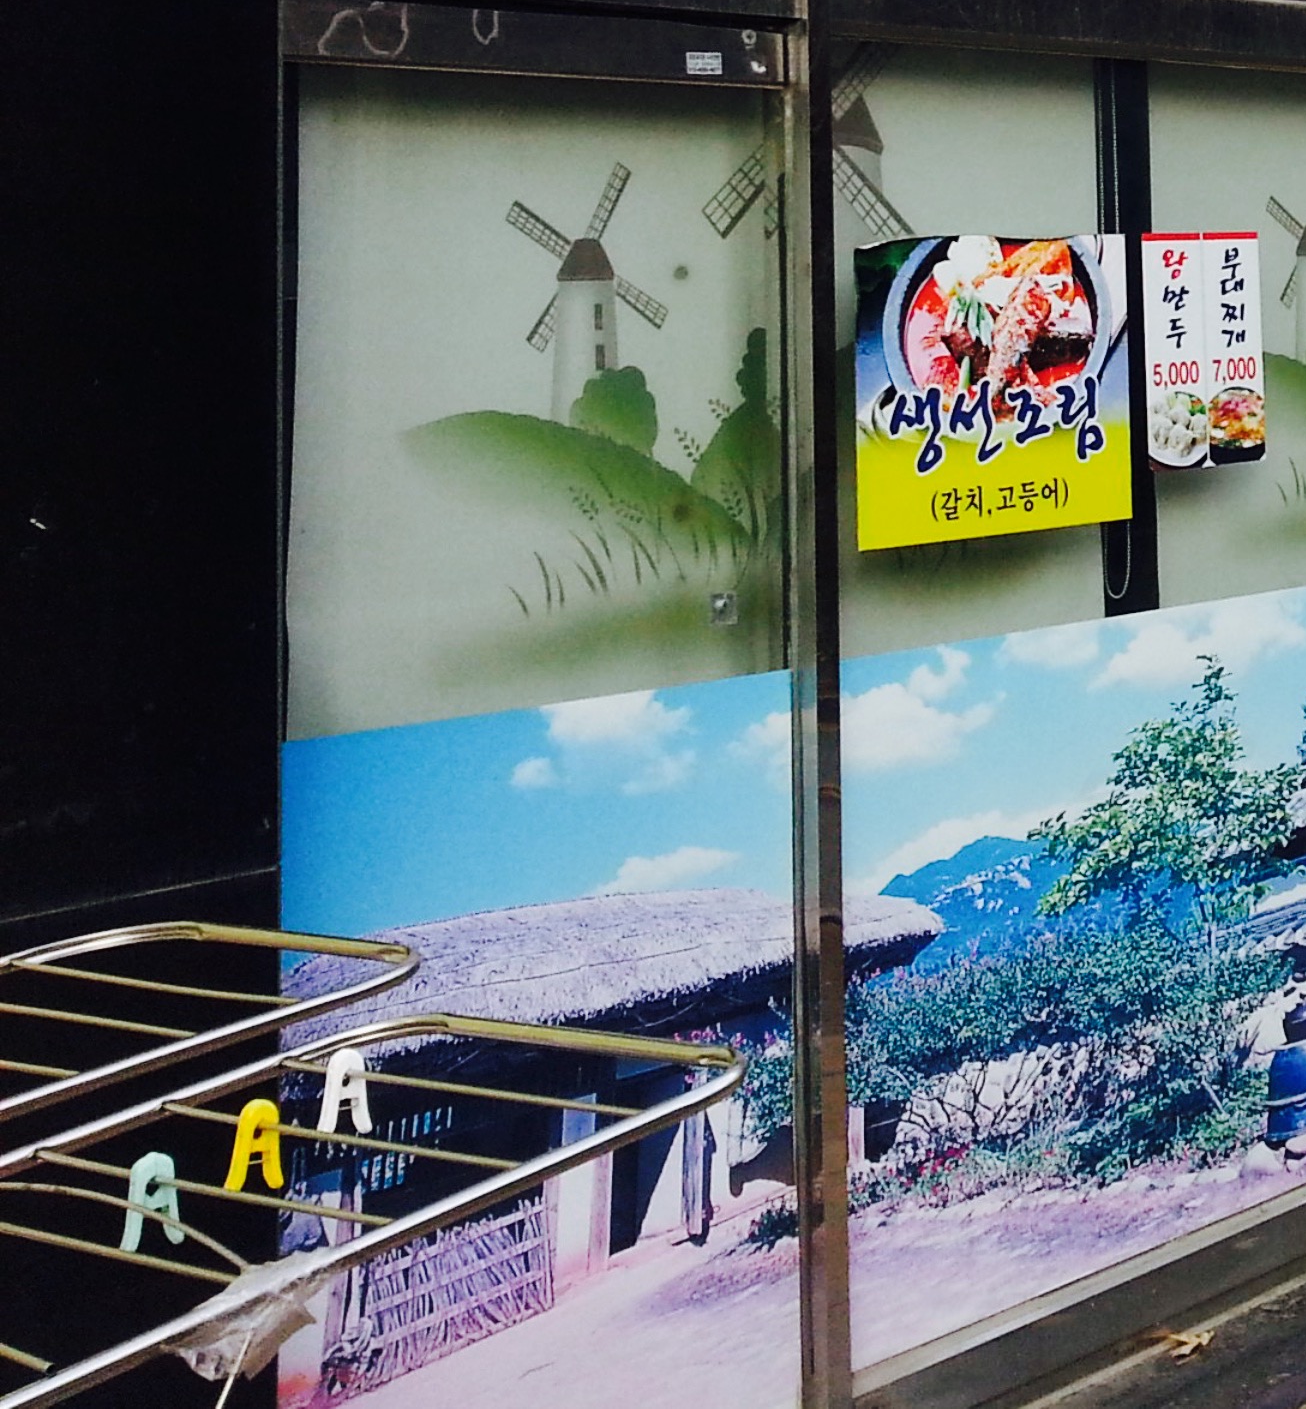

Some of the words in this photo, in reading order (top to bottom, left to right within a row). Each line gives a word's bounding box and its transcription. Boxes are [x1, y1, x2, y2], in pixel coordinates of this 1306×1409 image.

[1162, 248, 1189, 348] 왕만두
[1219, 247, 1249, 347] 부대찌개
[1152, 360, 1200, 387] 5,000
[1212, 356, 1257, 382] 7,000
[889, 378, 1106, 474] 생선조림
[930, 478, 1070, 521] (갈치,고등어)
